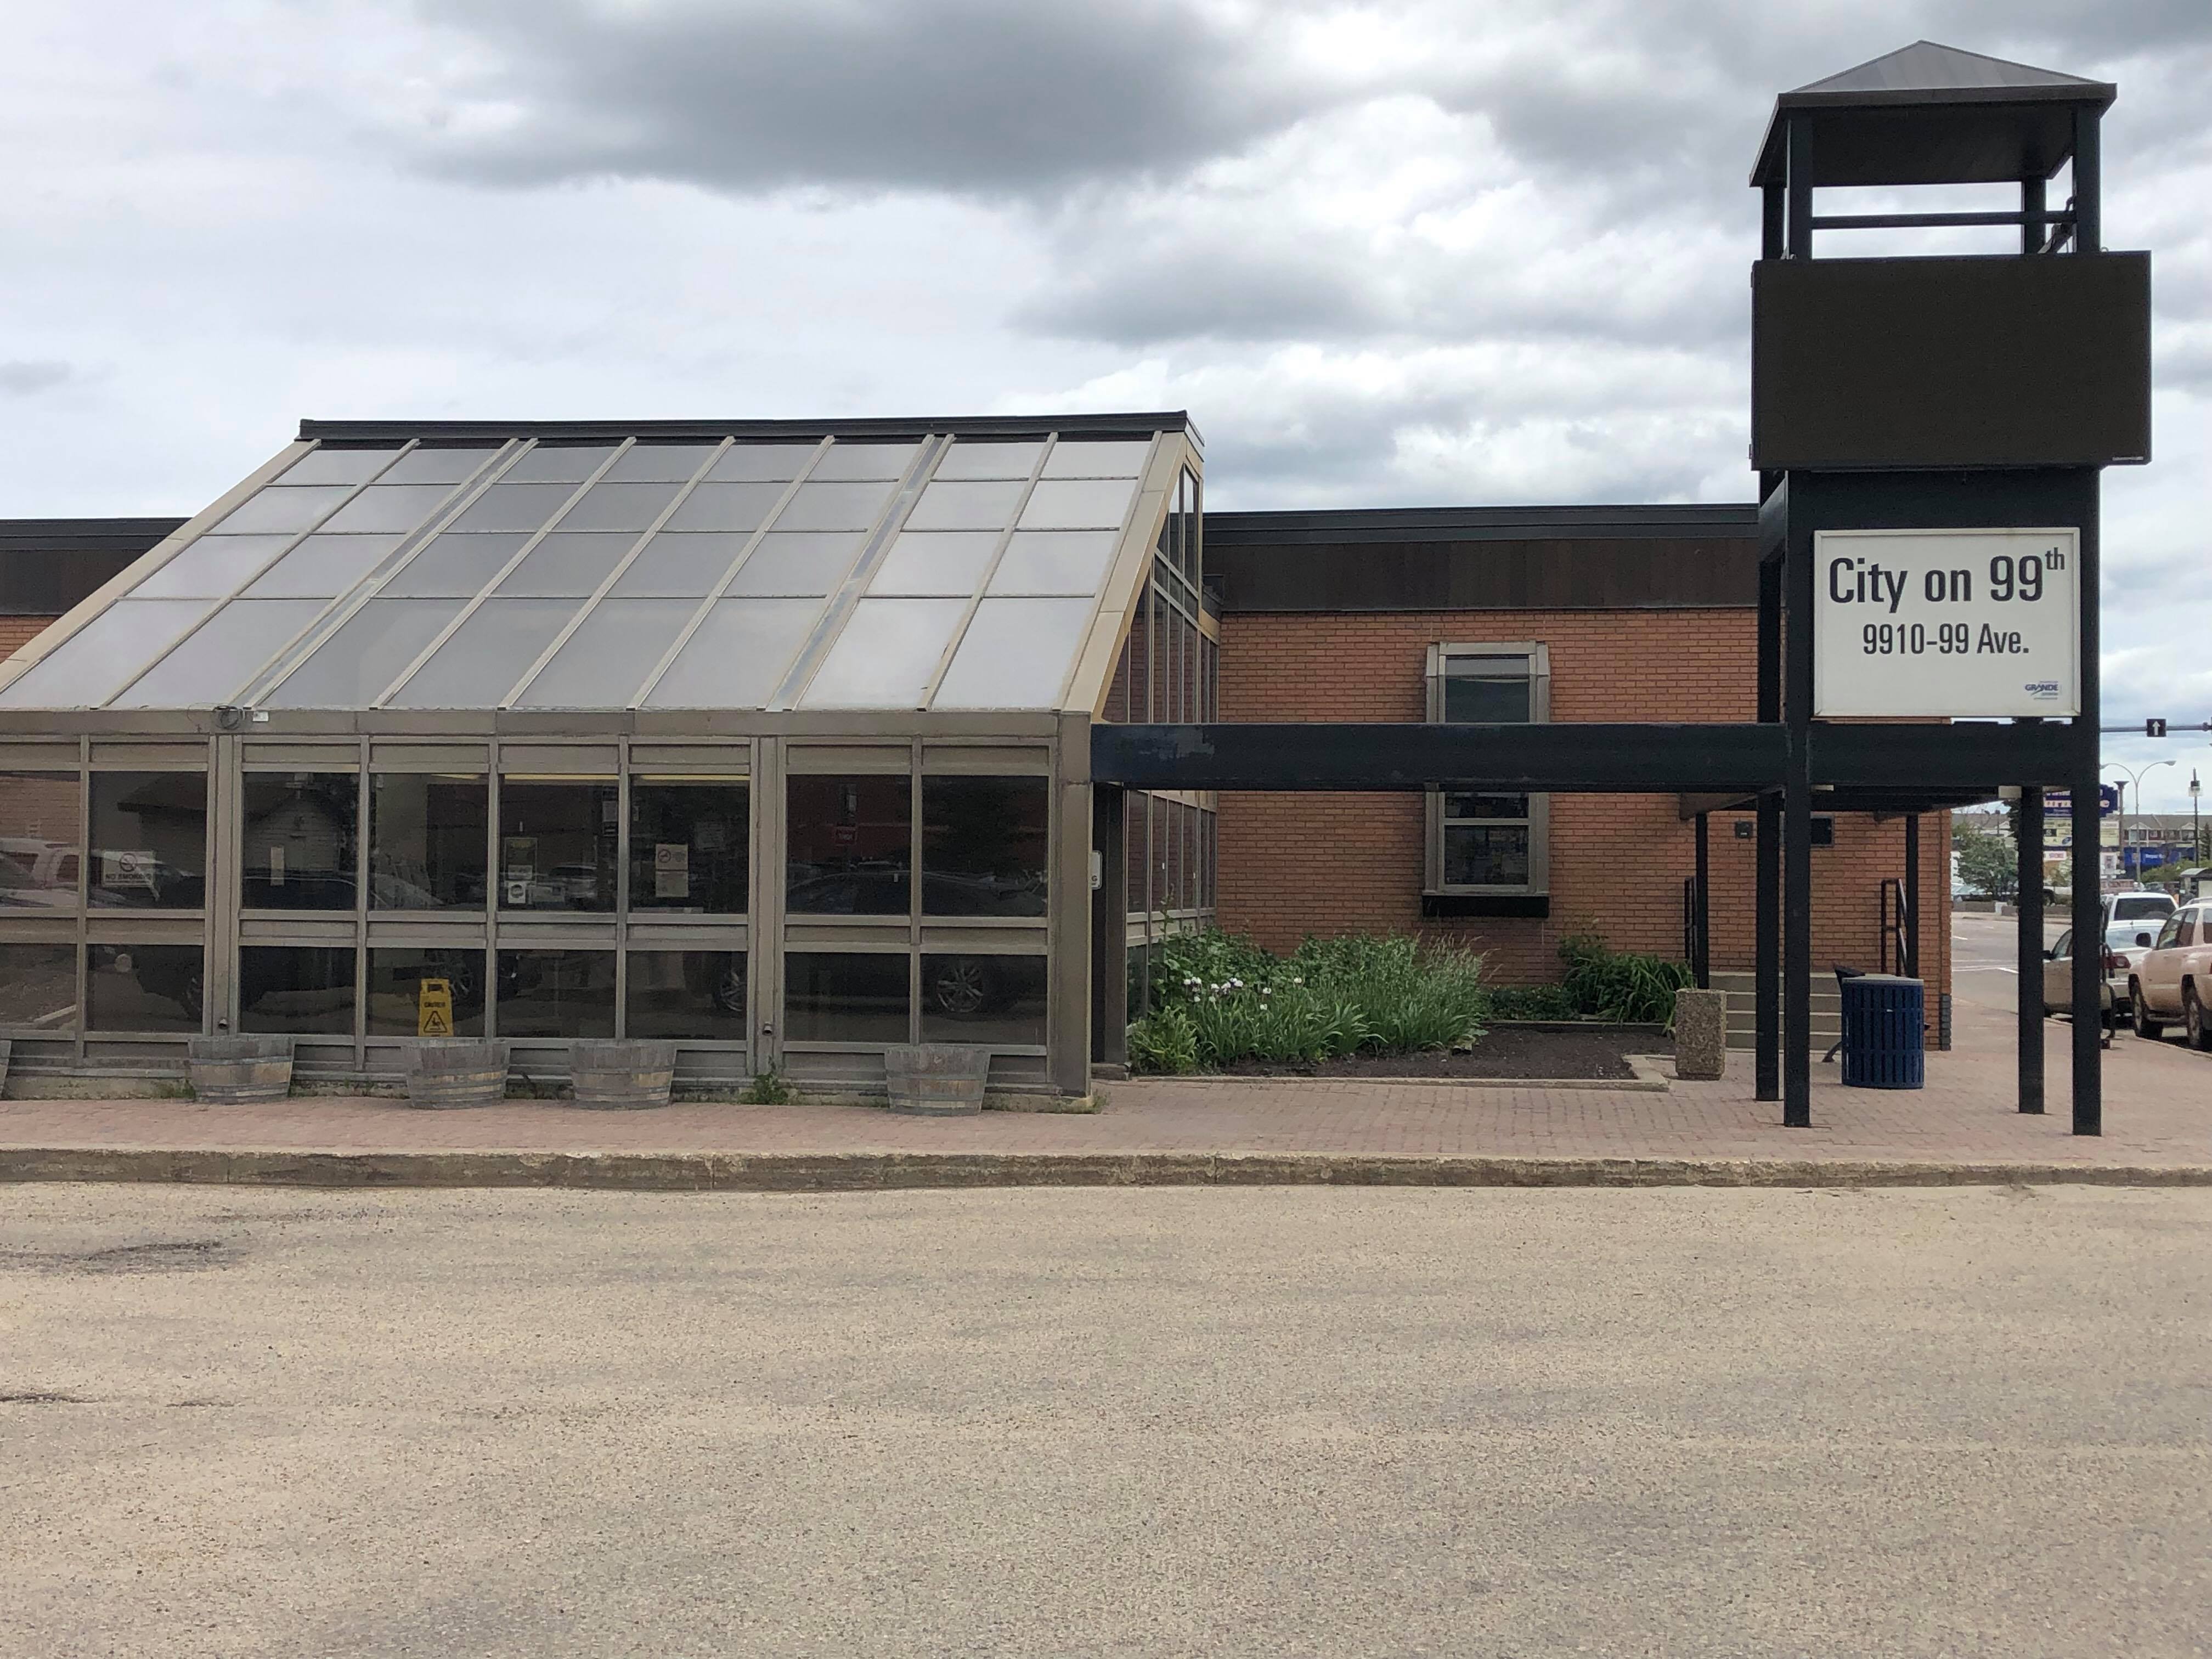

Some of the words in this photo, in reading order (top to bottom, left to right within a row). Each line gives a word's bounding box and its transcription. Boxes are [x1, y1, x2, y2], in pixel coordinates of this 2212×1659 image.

[1829, 557, 1908, 614] City
[1925, 569, 1972, 602] on
[1990, 547, 2066, 602] 99th
[1863, 623, 1969, 654] 9910-99
[1977, 623, 2029, 654] Ave.
